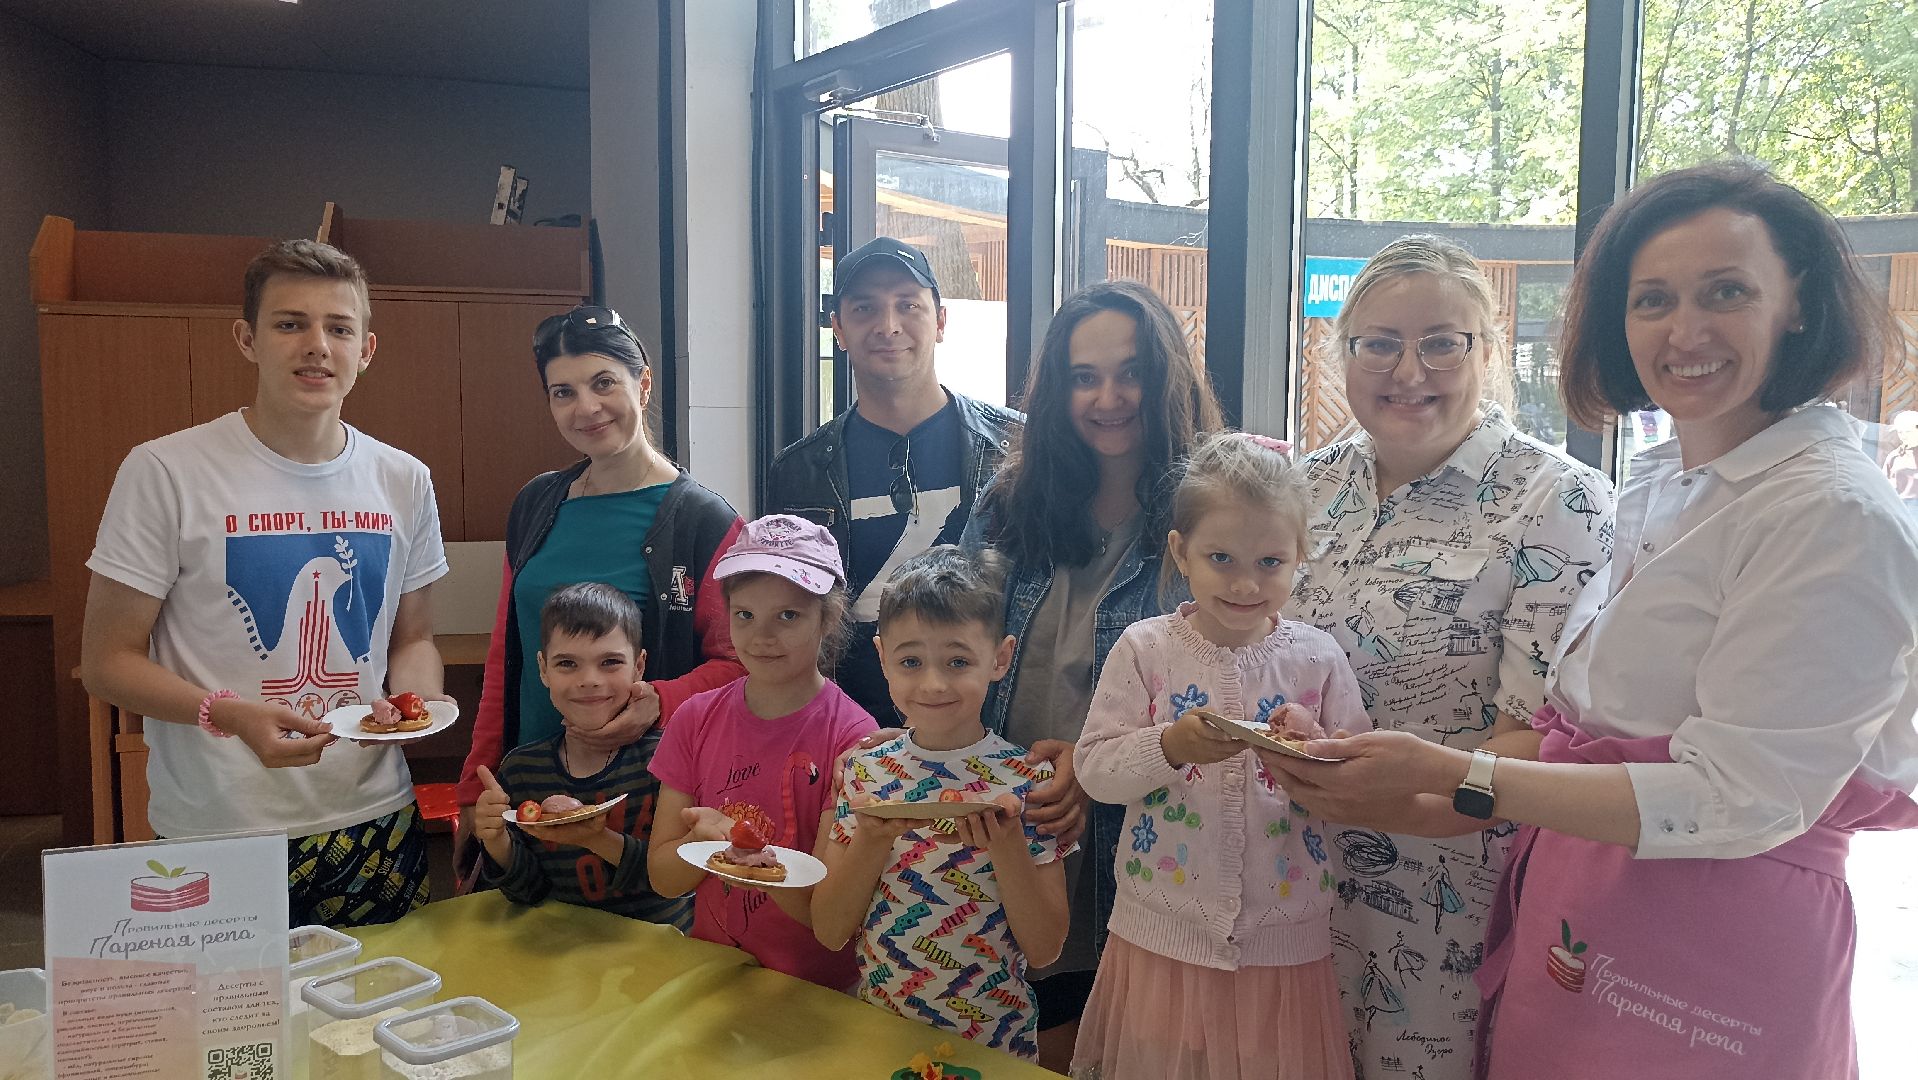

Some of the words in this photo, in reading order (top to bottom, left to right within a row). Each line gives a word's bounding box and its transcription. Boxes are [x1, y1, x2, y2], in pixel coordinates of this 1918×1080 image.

[225, 514, 238, 533] О
[248, 512, 312, 533] СПОРТ,
[320, 511, 393, 532] ТЫ-МИР!
[716, 762, 760, 795] Love
[89, 935, 196, 960] Пареная
[201, 929, 255, 952] репа
[1591, 979, 1686, 1035] Пареная
[1690, 1025, 1745, 1056] репа
